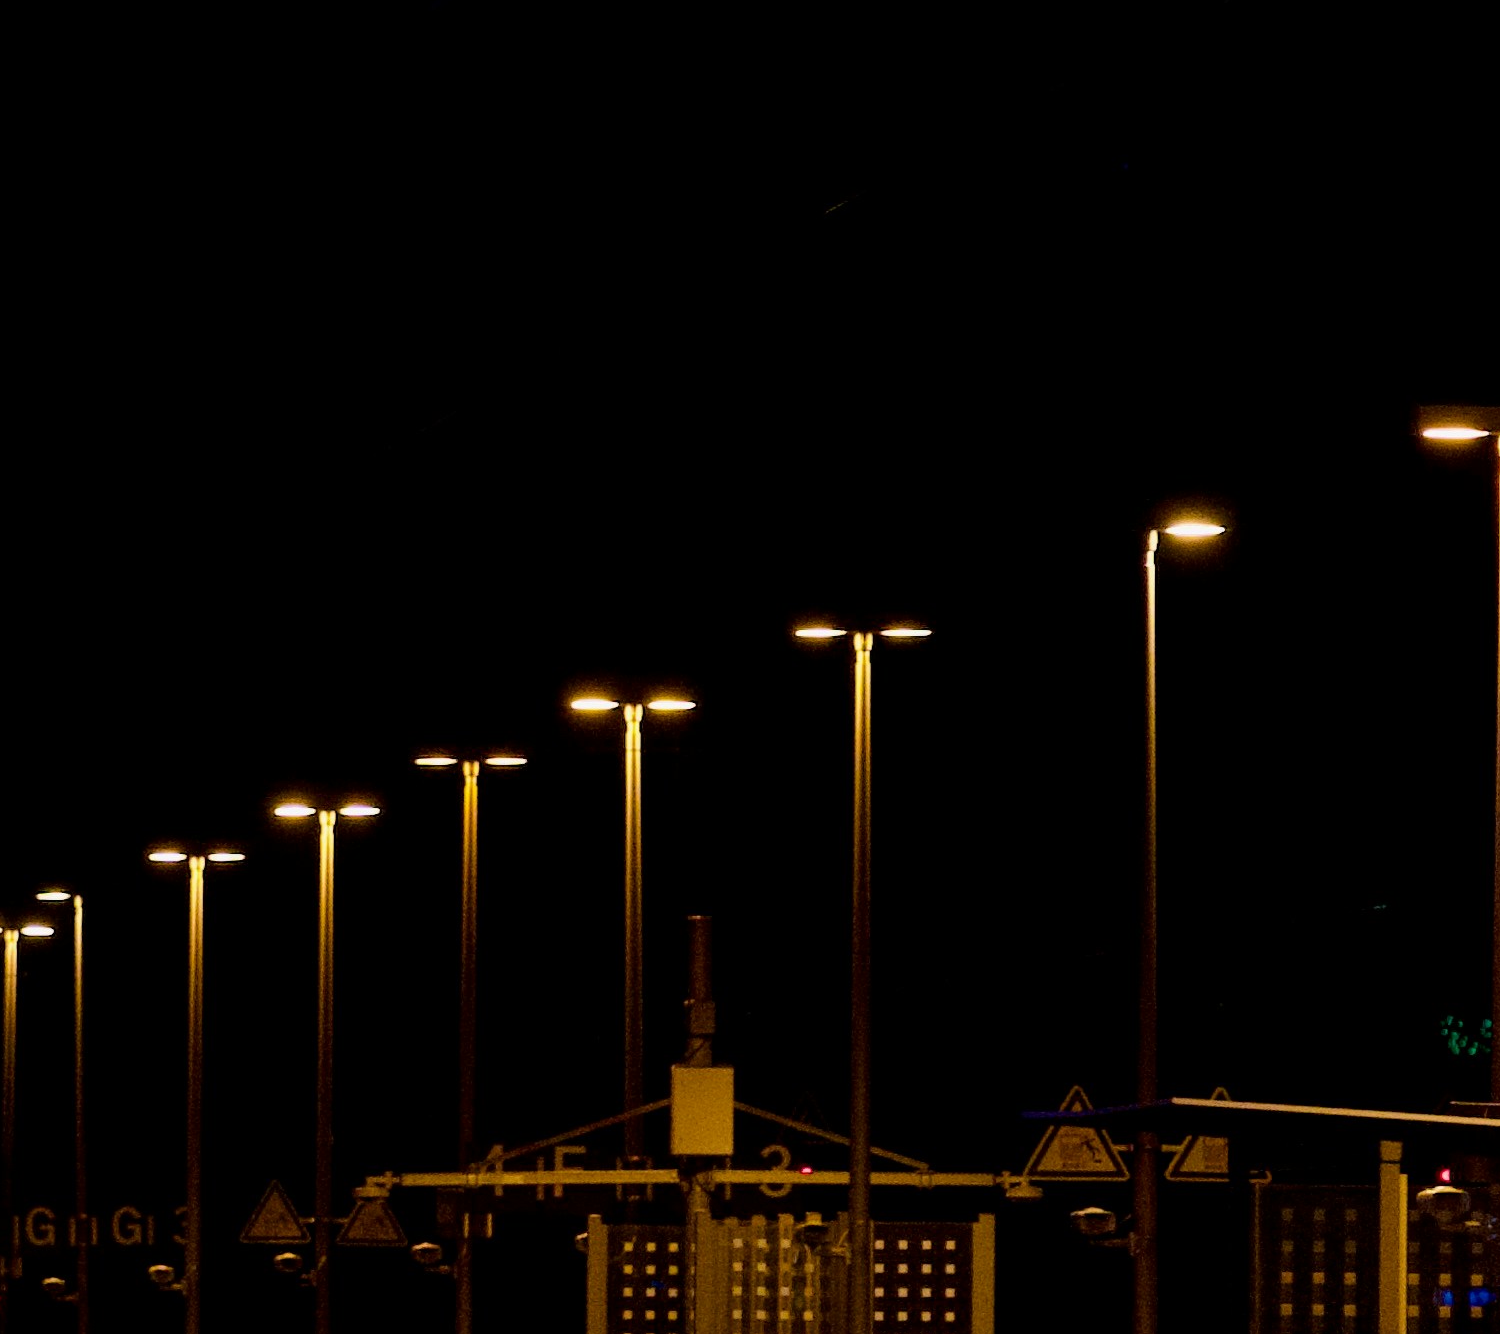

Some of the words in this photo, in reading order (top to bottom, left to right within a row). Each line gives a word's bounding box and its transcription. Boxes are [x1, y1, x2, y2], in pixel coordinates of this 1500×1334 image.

[759, 1144, 793, 1199] 3
[24, 1205, 57, 1247] G
[112, 1205, 143, 1247] G
